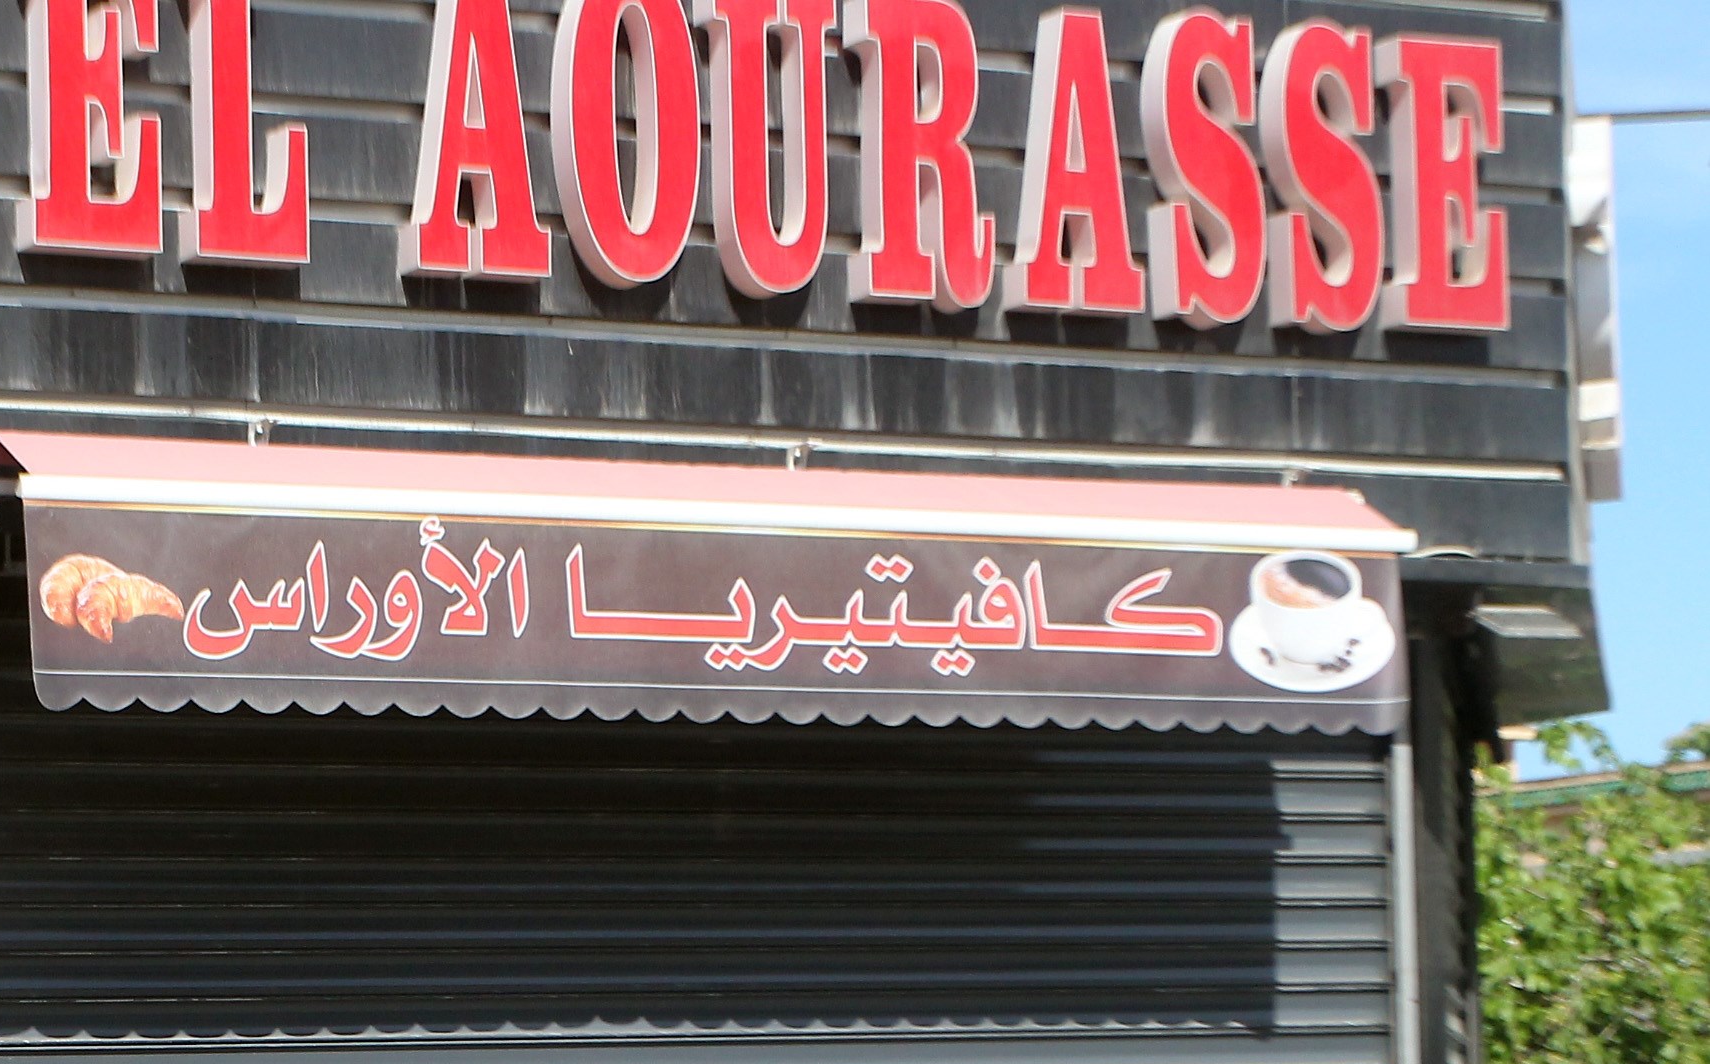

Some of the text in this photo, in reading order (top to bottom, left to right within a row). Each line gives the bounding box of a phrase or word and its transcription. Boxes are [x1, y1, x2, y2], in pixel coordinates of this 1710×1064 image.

[16, 0, 311, 268] EL
[397, 0, 1512, 336] AOURASSE
[182, 515, 530, 662] الأوراس
